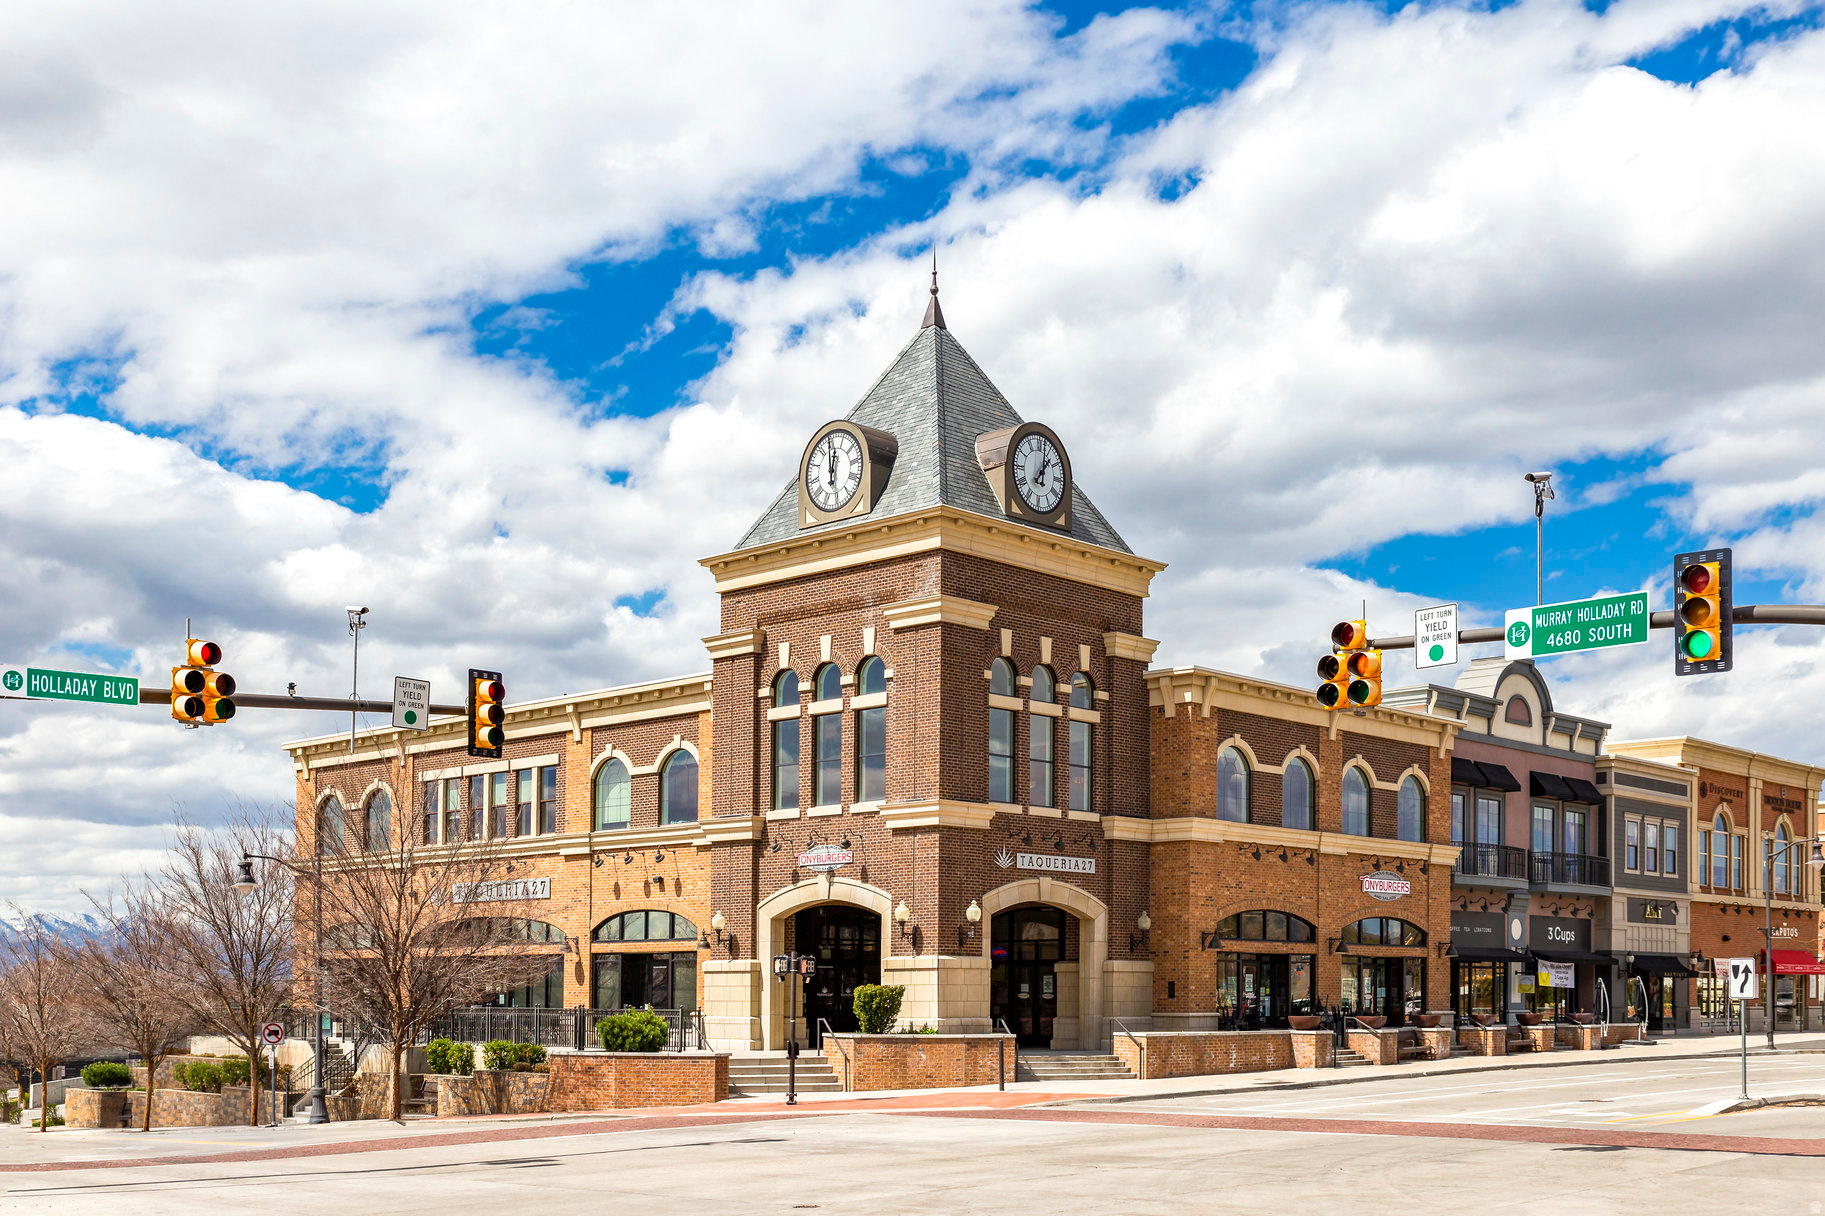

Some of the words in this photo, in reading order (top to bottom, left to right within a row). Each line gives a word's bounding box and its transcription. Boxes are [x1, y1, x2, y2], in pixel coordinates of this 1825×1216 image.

[1420, 612, 1434, 621] LEFT
[1436, 609, 1452, 619] TURN
[1535, 609, 1573, 629] MURRAY
[1577, 601, 1626, 623] HOLLADAY
[1630, 599, 1644, 616] RD
[1425, 620, 1448, 633] YIELD
[1420, 635, 1430, 644] ON
[1431, 631, 1452, 642] GREEN
[1546, 629, 1581, 647] 4680
[1588, 622, 1632, 642] SOUTH
[31, 674, 98, 697] HOLLADAY
[103, 681, 135, 700] BLVD
[412, 682, 426, 691] TURN
[403, 690, 421, 700] YIELD
[407, 701, 424, 709] GREEN
[795, 852, 852, 866] TONYBURGERS
[1020, 856, 1093, 872] TAQUERIA27
[1360, 876, 1410, 893] TONYBURGERS
[1547, 926, 1553, 940] 3
[1554, 926, 1575, 944] Cups
